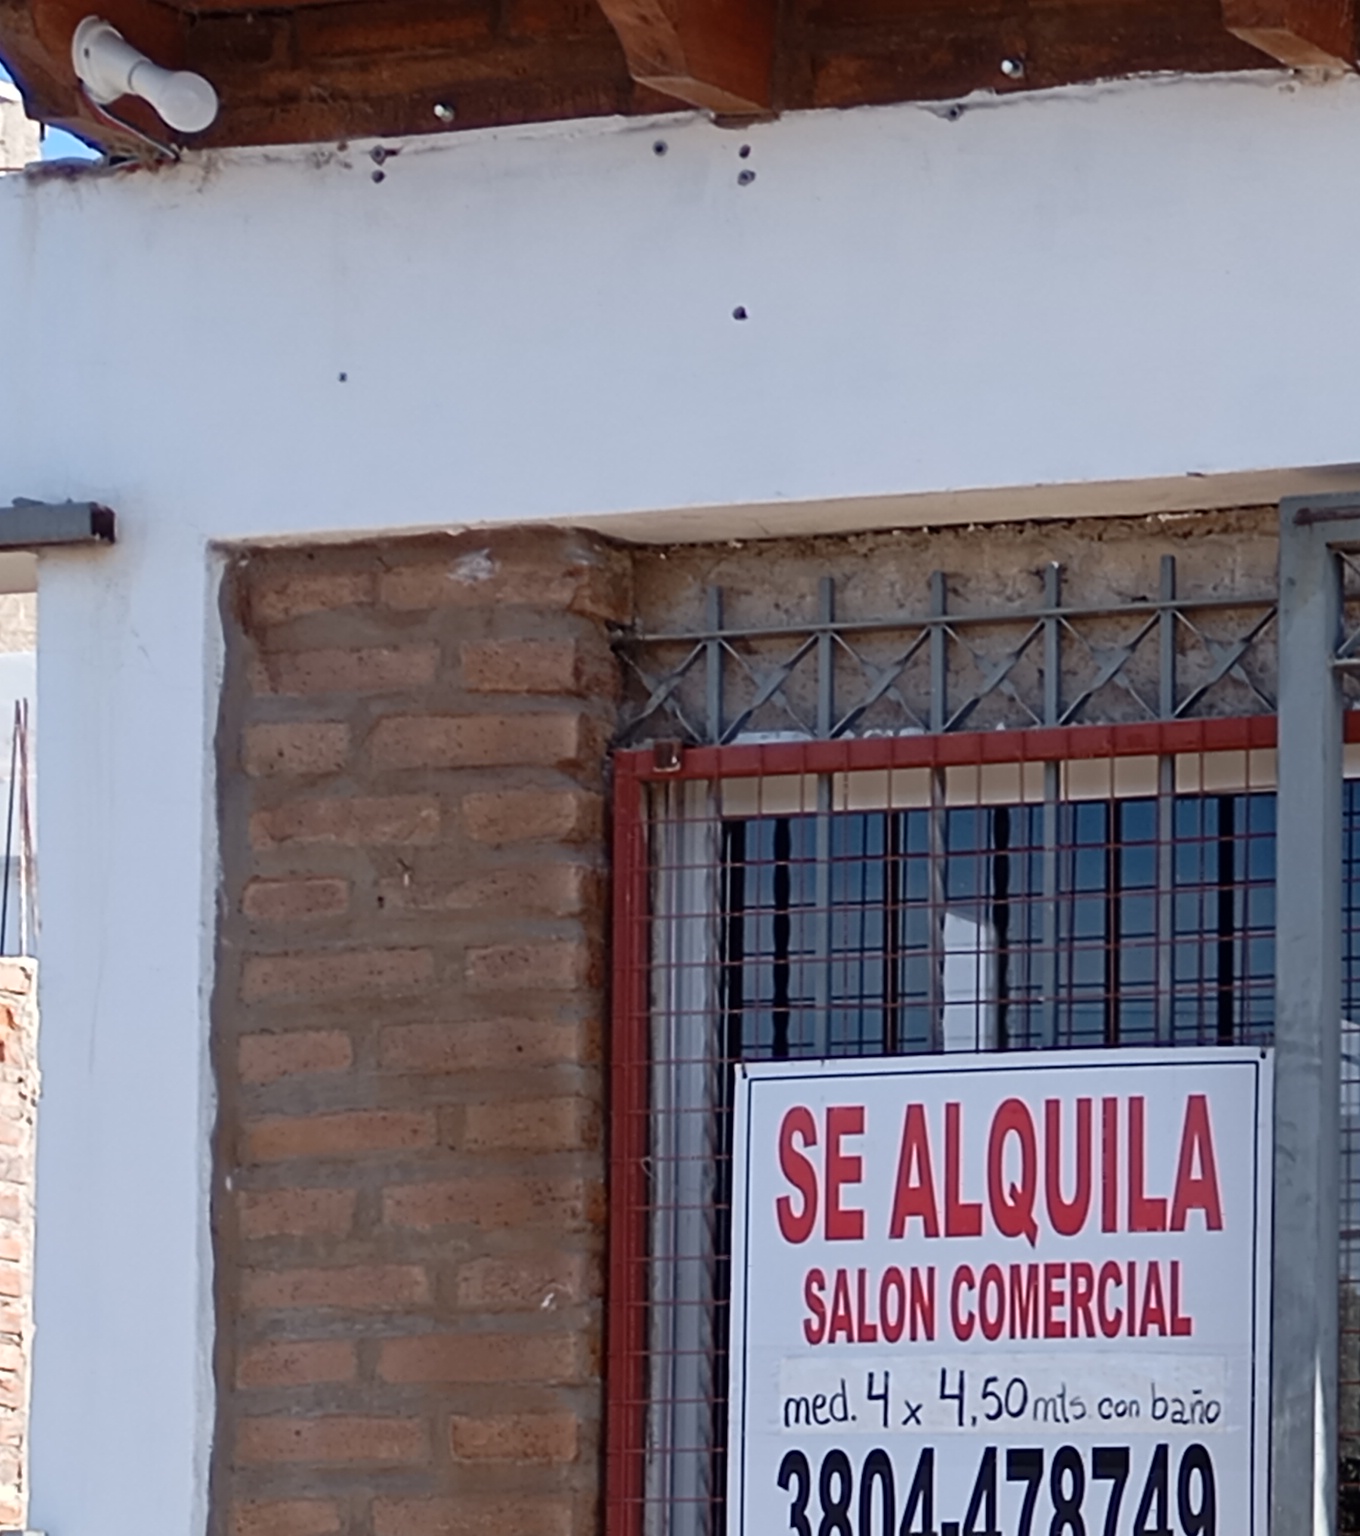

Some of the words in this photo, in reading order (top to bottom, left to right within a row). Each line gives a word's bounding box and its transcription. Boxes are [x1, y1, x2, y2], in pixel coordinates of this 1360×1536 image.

[776, 1104, 866, 1244] SE
[889, 1094, 1223, 1248] ALQUILA
[803, 1265, 936, 1345] SALON
[951, 1260, 1192, 1342] COMERCIAL
[783, 1377, 858, 1428] med.
[866, 1371, 890, 1429] 4
[902, 1400, 923, 1427] x
[938, 1367, 1029, 1429] 4,50
[1097, 1395, 1140, 1420] con
[1150, 1381, 1221, 1425] baño
